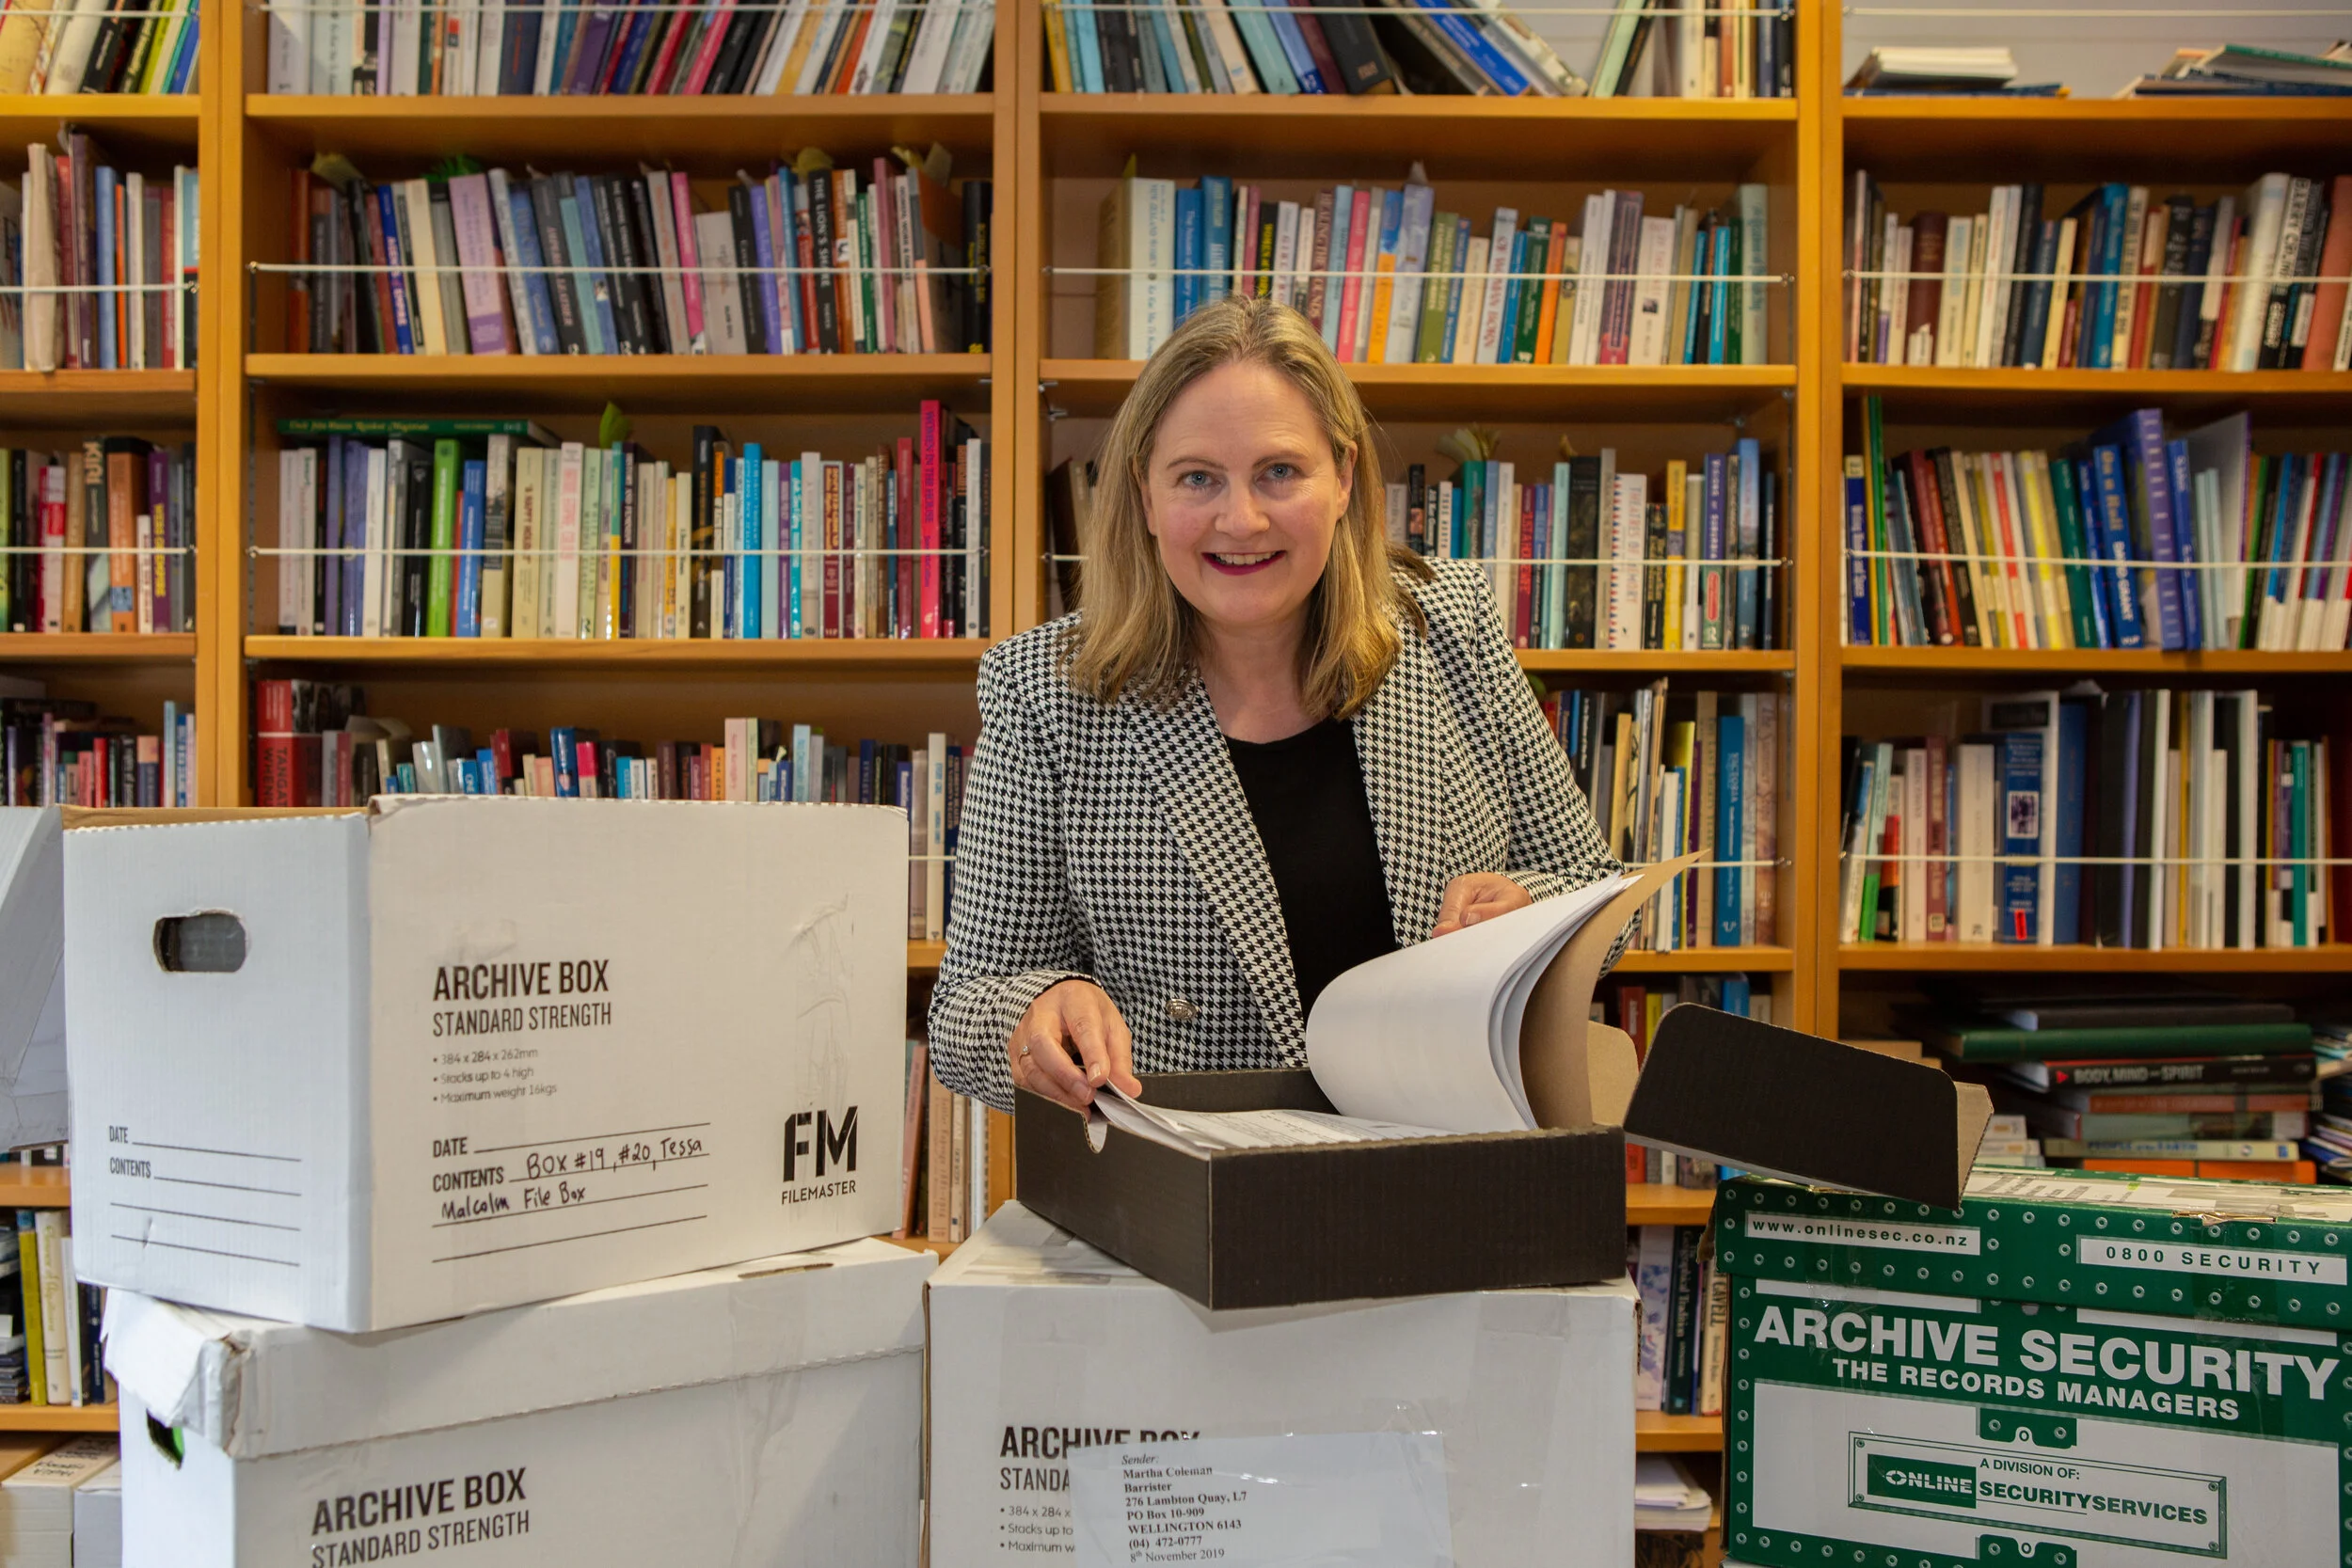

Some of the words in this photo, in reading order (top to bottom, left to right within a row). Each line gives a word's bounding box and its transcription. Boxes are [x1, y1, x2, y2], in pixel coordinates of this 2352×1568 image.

[814, 178, 825, 199] THE
[816, 204, 828, 245] LION'S
[925, 411, 934, 451] WOMEN
[926, 453, 933, 466] IN
[925, 467, 933, 486] THE
[925, 488, 933, 523] HOUSE
[1628, 487, 1642, 537] THEATRES
[1628, 541, 1639, 554] OF
[2118, 579, 2134, 621] GRANT
[263, 748, 274, 807] WHENU
[277, 748, 288, 807] TANGAT
[433, 960, 551, 1002] ARCHIVE
[559, 959, 610, 993] BOX
[433, 1007, 524, 1038] STANDARD
[529, 1002, 612, 1030] STRENGTH
[441, 1052, 461, 1066] 384
[471, 1051, 491, 1064] 284
[501, 1046, 538, 1061] 262mm
[440, 1070, 474, 1085] Stacks
[475, 1069, 489, 1085] up
[491, 1069, 501, 1082] to
[502, 1069, 511, 1080] 4
[512, 1066, 534, 1082] high
[440, 1091, 491, 1105] Maximum
[493, 1085, 527, 1101] weight
[529, 1082, 558, 1099] 16kgs
[109, 1125, 128, 1144] DATE
[783, 1105, 859, 1183] FM
[433, 1136, 469, 1159] DATE
[110, 1157, 151, 1179] CONTENTS
[433, 1166, 504, 1194] CONTENTS
[441, 1196, 511, 1222] Malcolm
[523, 1186, 551, 1210] File
[558, 1184, 587, 1205] Box
[781, 1180, 857, 1205] FILEMASTER
[1752, 1217, 1969, 1248] www.onlinesec.co.nz
[2106, 1245, 2167, 1264] 0800
[2180, 1250, 2323, 1276] SECURITY
[1676, 1294, 1689, 1338] Tradition
[1709, 1283, 1726, 1327] CAVELL
[1754, 1306, 2000, 1366] ARCHIVE
[2019, 1328, 2342, 1402] SECURITY
[1833, 1358, 1890, 1385] THE
[1899, 1365, 2045, 1401] RECORDS
[2057, 1381, 2241, 1420] MANAGERS
[1121, 1452, 1158, 1466] Sender:
[1979, 1457, 1991, 1470] A
[1994, 1459, 2051, 1477] DIVISION
[2054, 1465, 2081, 1481] OF:
[1000, 1466, 1071, 1492] STANDA
[1123, 1466, 1163, 1481] Martha
[1166, 1465, 1213, 1479] Coleman
[1884, 1468, 1974, 1496] ONLINE
[1123, 1481, 1172, 1494] Barrister
[1125, 1495, 1144, 1508] 276
[1146, 1493, 1194, 1507] Lambton
[1198, 1491, 1232, 1506] Quay,
[1233, 1491, 1247, 1502] L7
[311, 1479, 454, 1537] ARCHIVE
[464, 1467, 527, 1510] BOX
[1008, 1506, 1031, 1517] 384
[1041, 1506, 1062, 1517] 284
[1127, 1509, 1143, 1520] PO
[1146, 1509, 1168, 1519] Box
[1170, 1507, 1205, 1519] 10-909
[312, 1528, 421, 1568] STANDARD
[428, 1510, 530, 1550] STRENGTH
[1008, 1523, 1042, 1536] Stacks
[1044, 1525, 1060, 1538] up
[1062, 1526, 1073, 1536] to
[1128, 1521, 1214, 1535] WELLINGTON
[1216, 1519, 1242, 1531] 6143
[1008, 1540, 1057, 1553] Maximum
[1129, 1537, 1151, 1550] (04)
[1154, 1534, 1202, 1548] 472-0777
[1145, 1549, 1197, 1563] November
[1200, 1547, 1225, 1560] 2019
